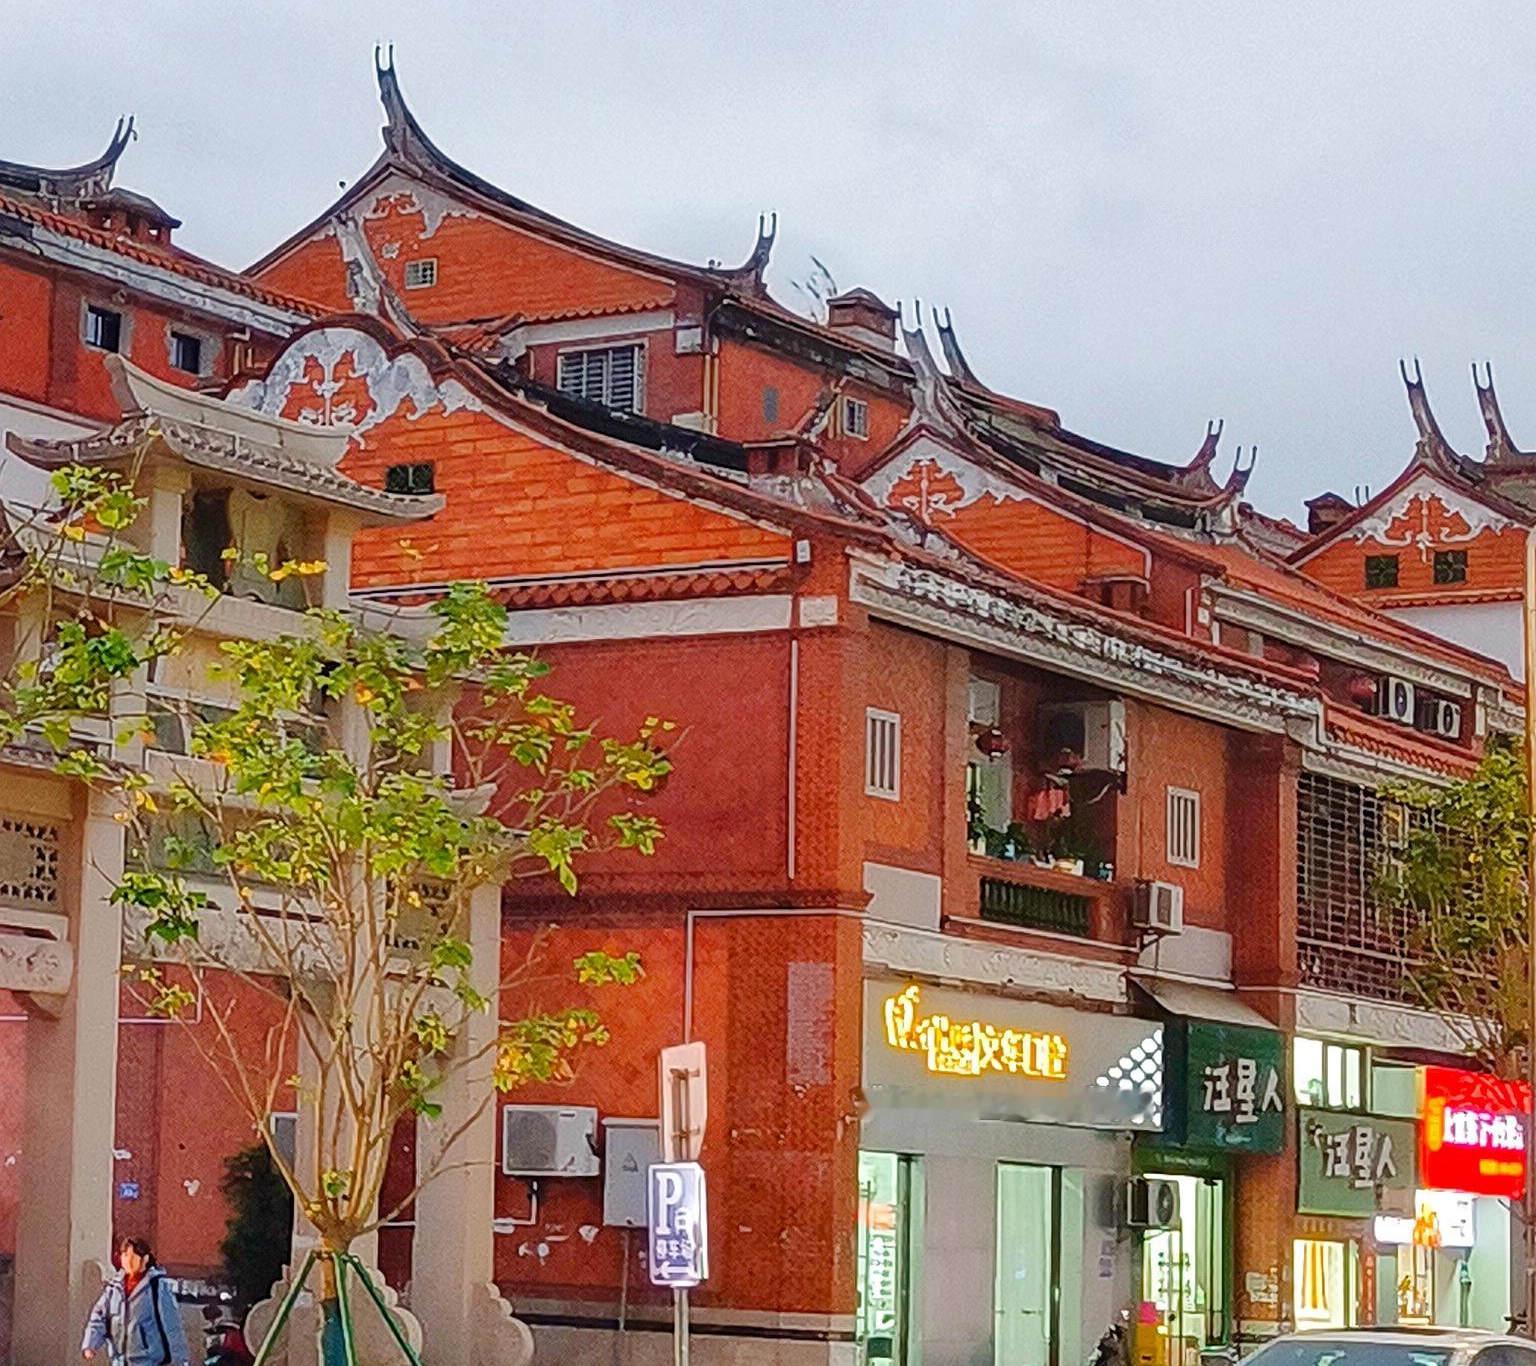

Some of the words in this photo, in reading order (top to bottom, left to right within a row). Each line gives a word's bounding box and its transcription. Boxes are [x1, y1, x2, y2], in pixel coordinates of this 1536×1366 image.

[1203, 1058, 1283, 1124] 汪星人
[1325, 1126, 1397, 1188] 汪星人
[655, 1172, 683, 1235] P
